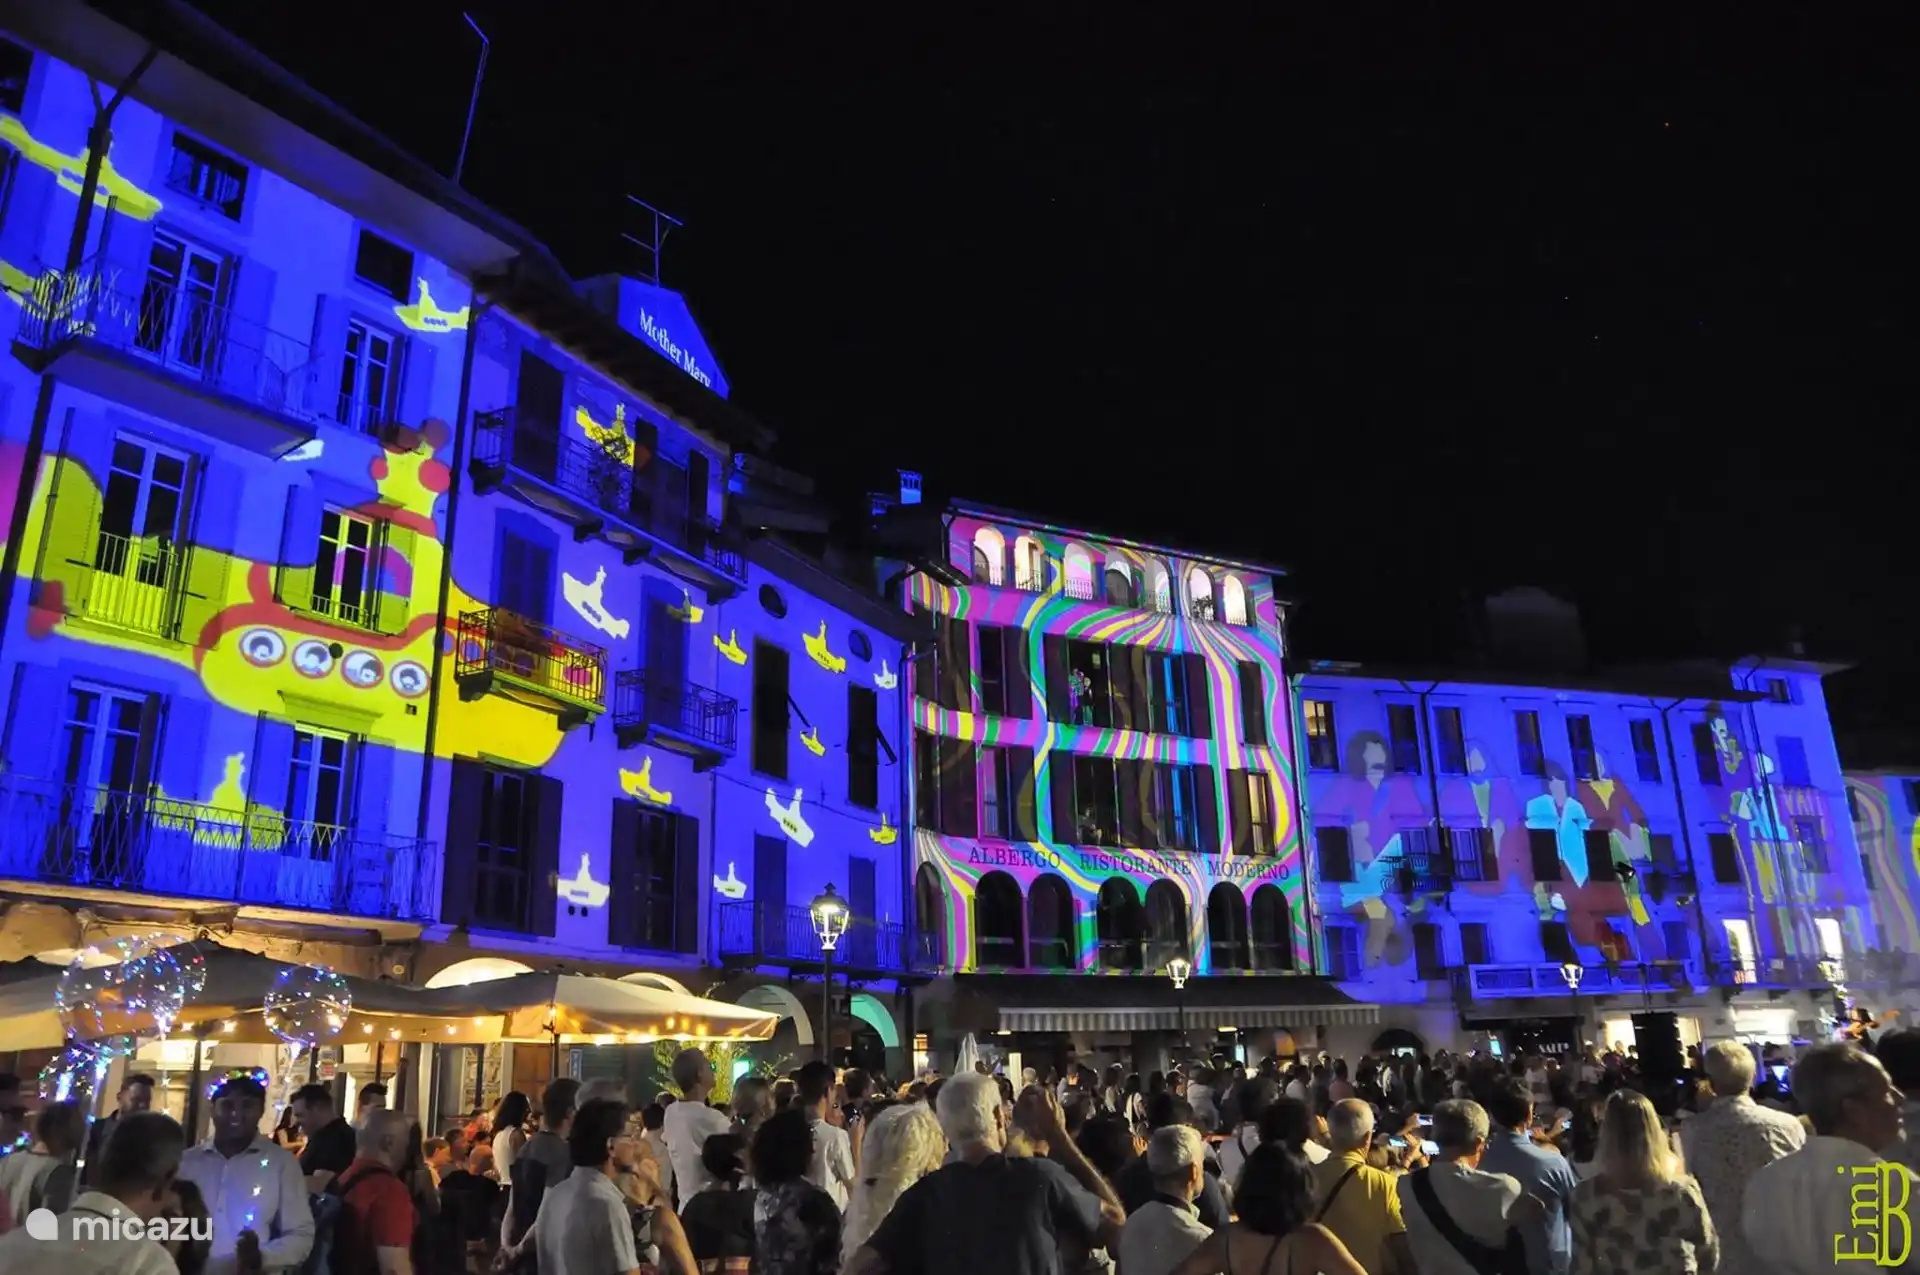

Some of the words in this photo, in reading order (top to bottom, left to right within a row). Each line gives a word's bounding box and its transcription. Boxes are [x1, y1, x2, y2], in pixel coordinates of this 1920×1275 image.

[640, 307, 682, 364] Mother
[968, 846, 1061, 869] ALBERGO
[1080, 853, 1192, 876] RISTORANTE
[1207, 860, 1290, 881] MODERNO
